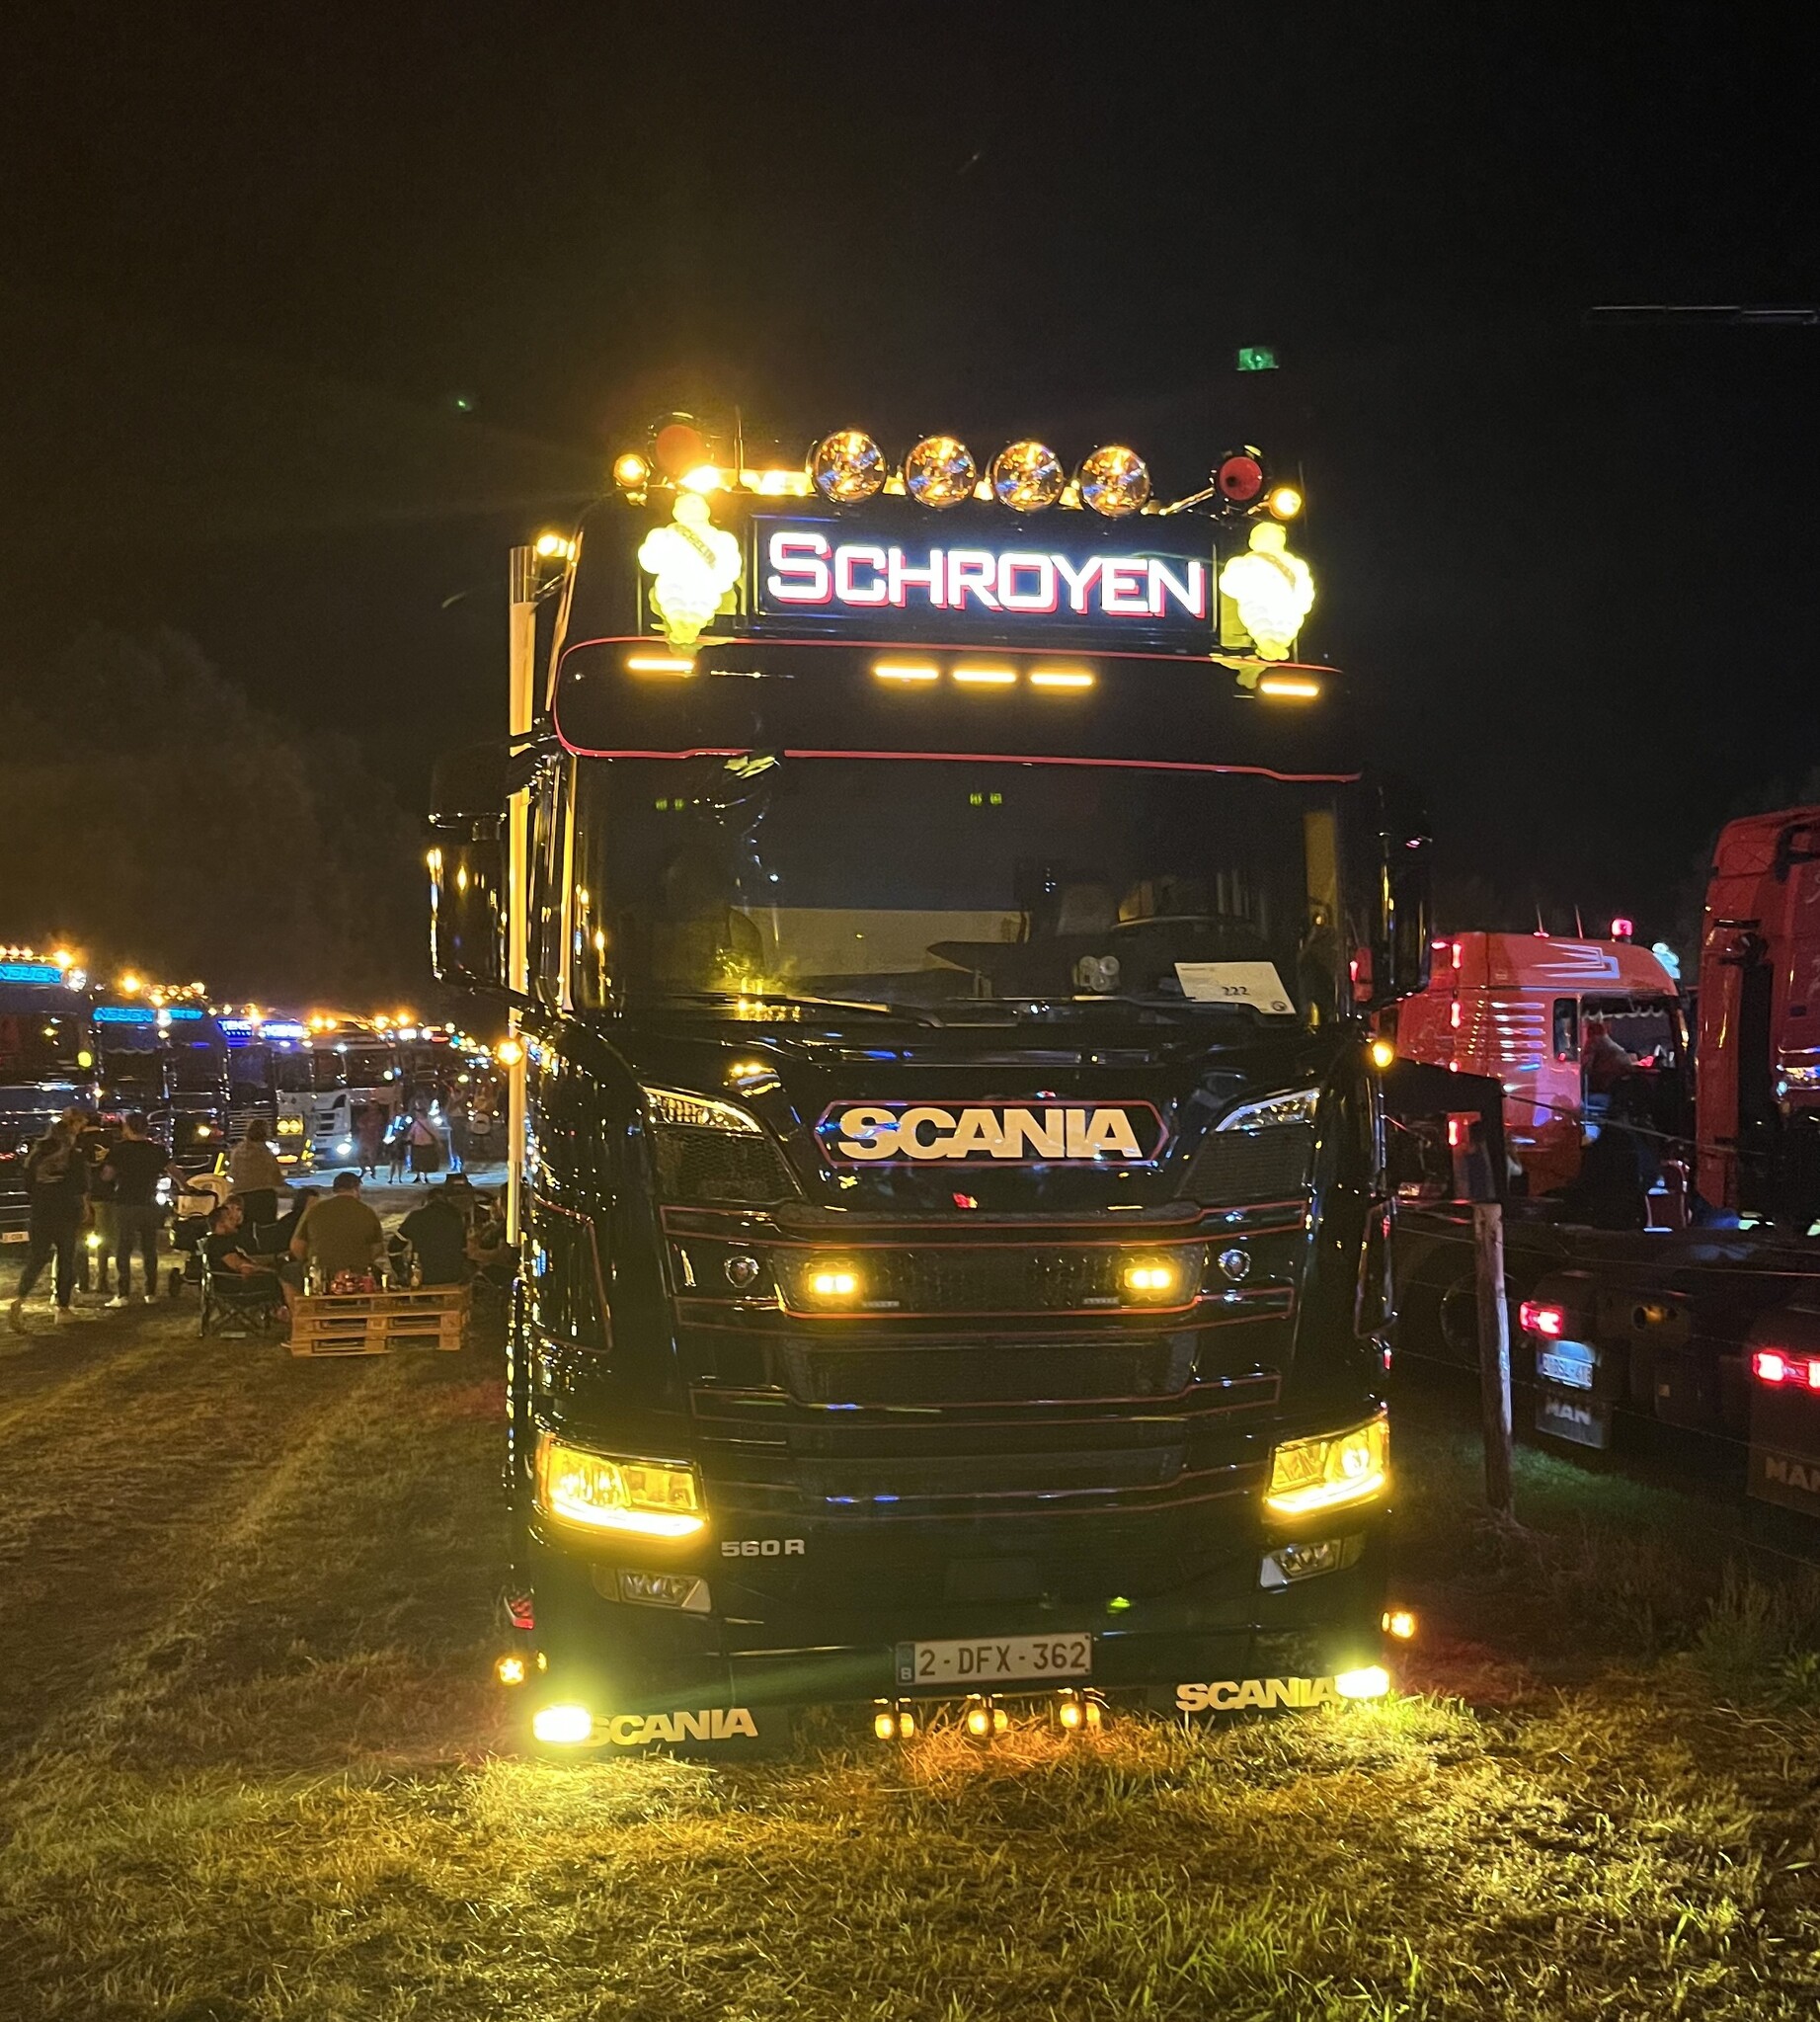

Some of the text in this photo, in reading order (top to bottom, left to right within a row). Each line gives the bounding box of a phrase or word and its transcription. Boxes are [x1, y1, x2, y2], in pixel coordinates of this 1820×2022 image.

[767, 531, 1206, 618] SCHROYEN
[1222, 986, 1250, 997] 222
[838, 1107, 1143, 1160] SCANIA
[1545, 1400, 1591, 1425] MAN
[721, 1539, 805, 1557] 560 R
[901, 1667, 912, 1679] B
[1176, 1677, 1337, 1711] SCANIA
